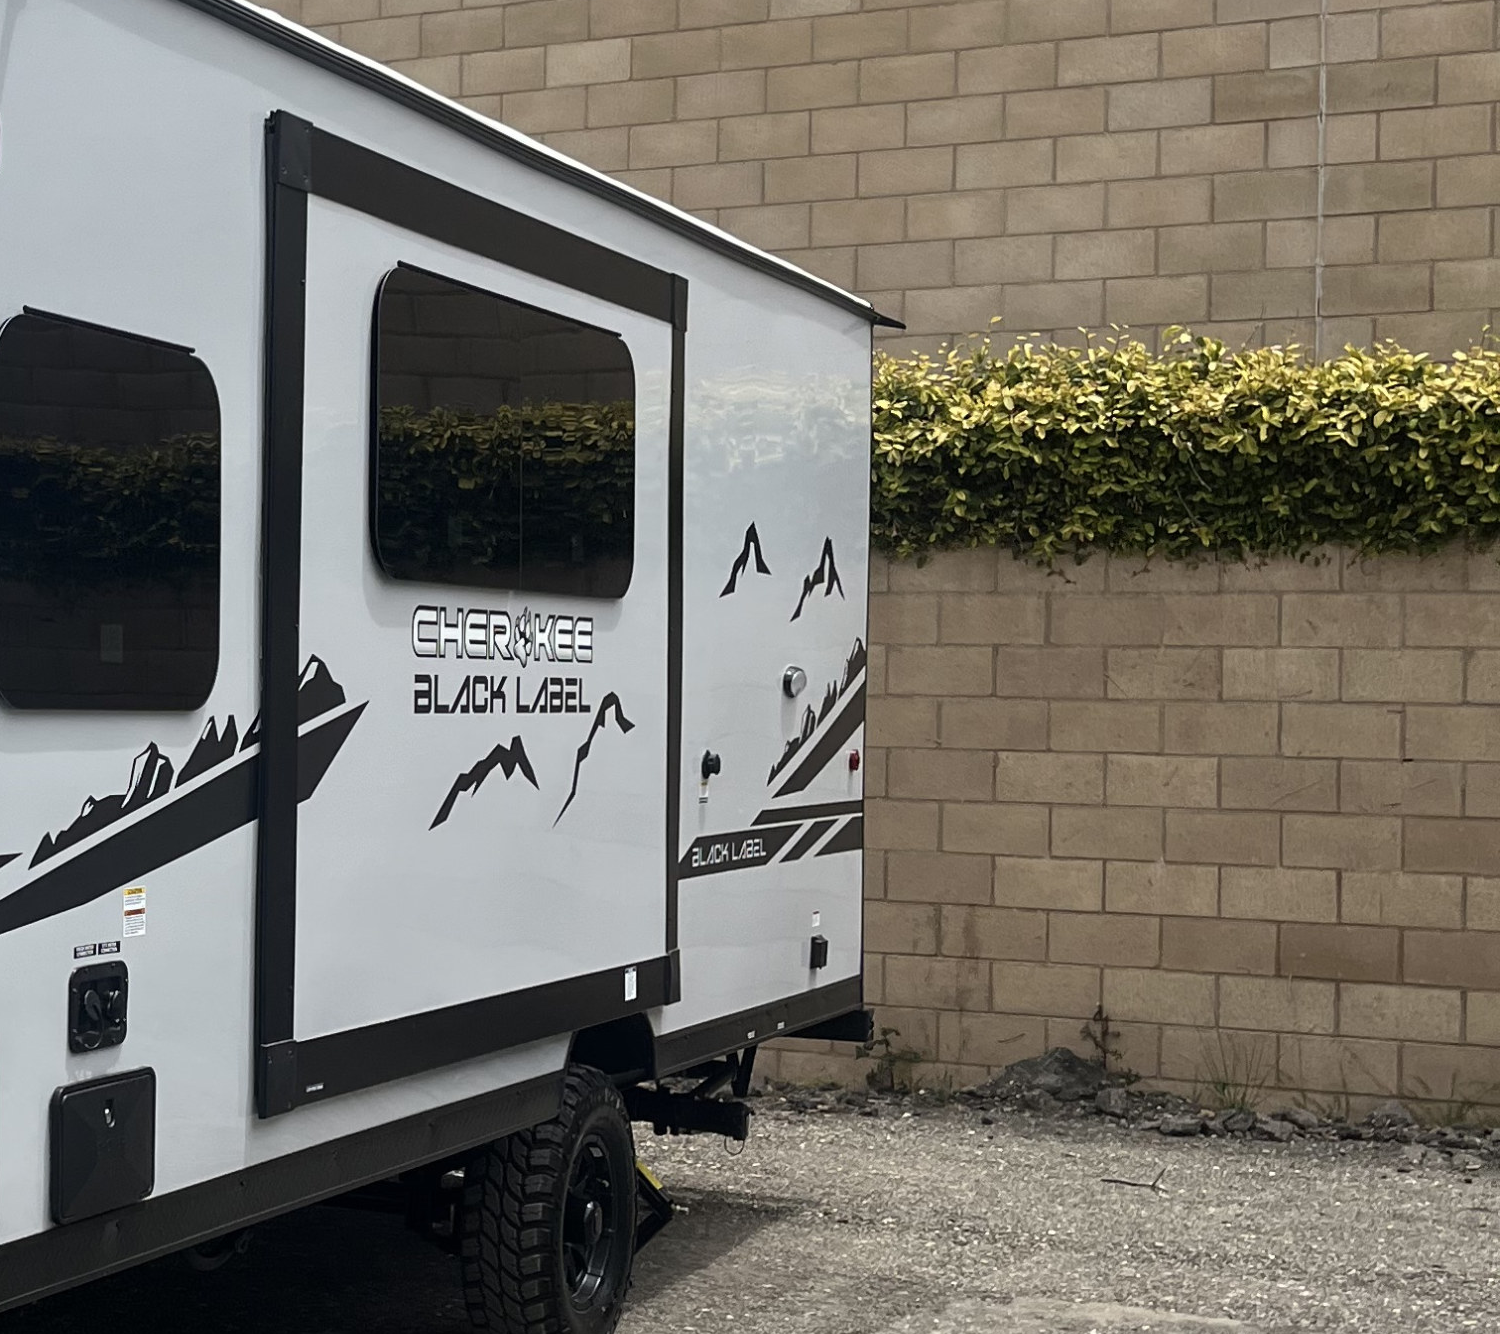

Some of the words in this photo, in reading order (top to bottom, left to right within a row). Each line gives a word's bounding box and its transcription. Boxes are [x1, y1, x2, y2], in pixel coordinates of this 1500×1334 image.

[413, 674, 508, 714] BLACK
[516, 676, 591, 714] LABEL
[691, 843, 729, 868] BLACK
[731, 838, 767, 861] LABEL
